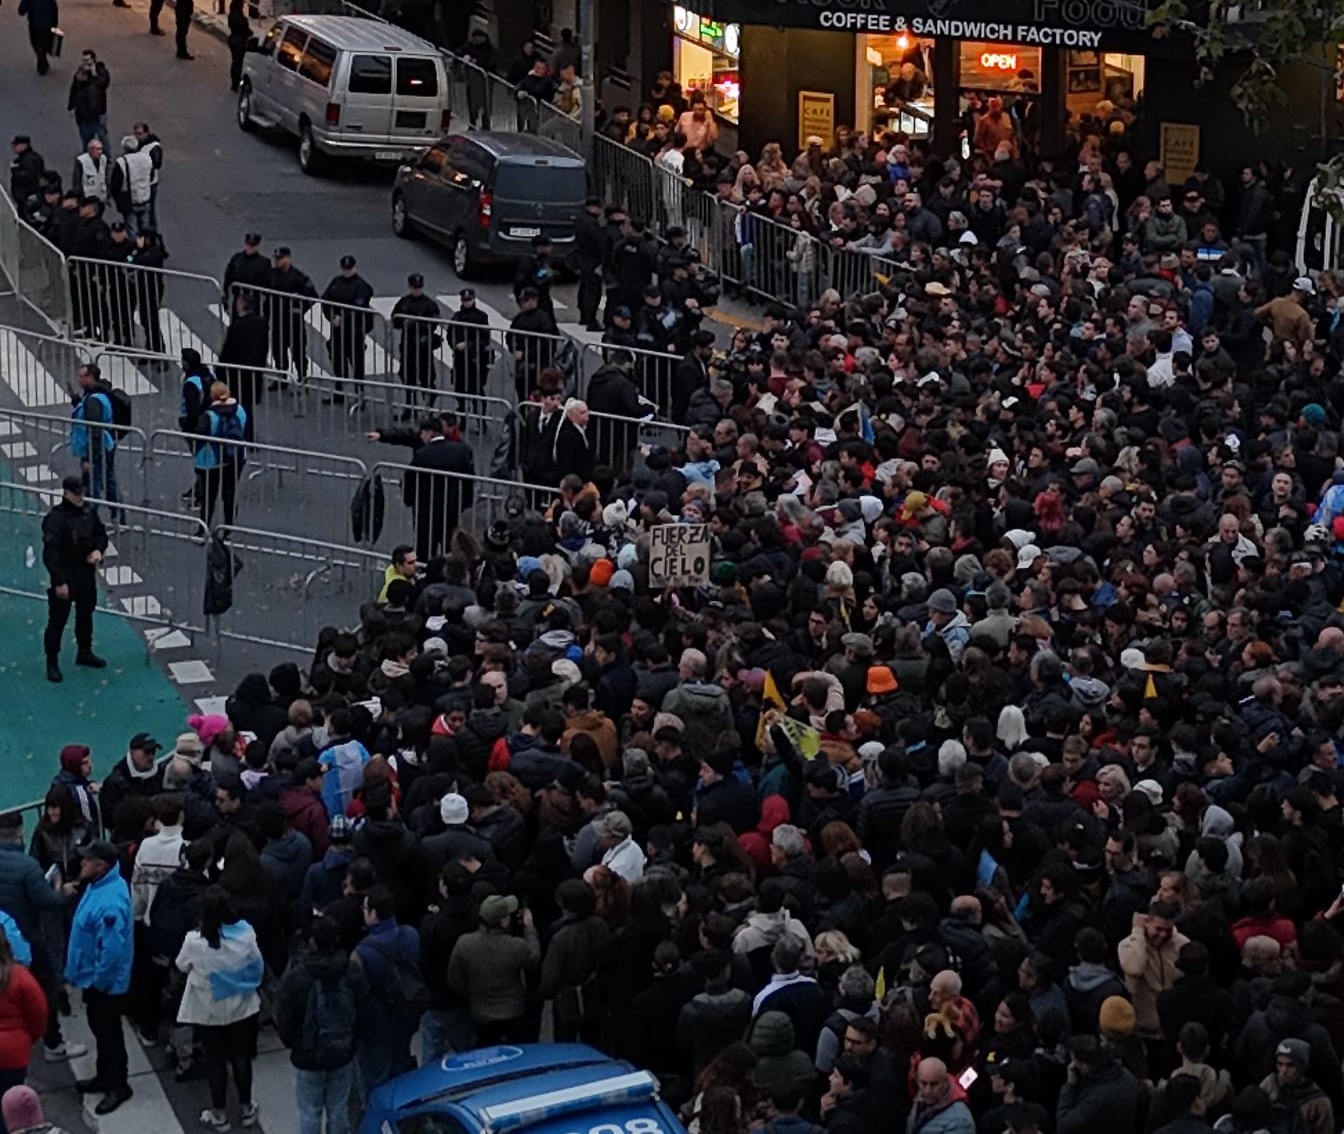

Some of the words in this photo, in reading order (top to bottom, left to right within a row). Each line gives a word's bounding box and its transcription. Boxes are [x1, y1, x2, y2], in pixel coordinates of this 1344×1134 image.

[820, 10, 891, 32] COFFEE
[894, 16, 908, 32] &
[911, 17, 1014, 41] SANDWICH
[1017, 25, 1103, 48] FACTORY
[980, 53, 1017, 70] OPEN
[652, 525, 709, 547] FUERZA
[666, 544, 686, 557] DEL
[651, 556, 706, 577] CIELO
